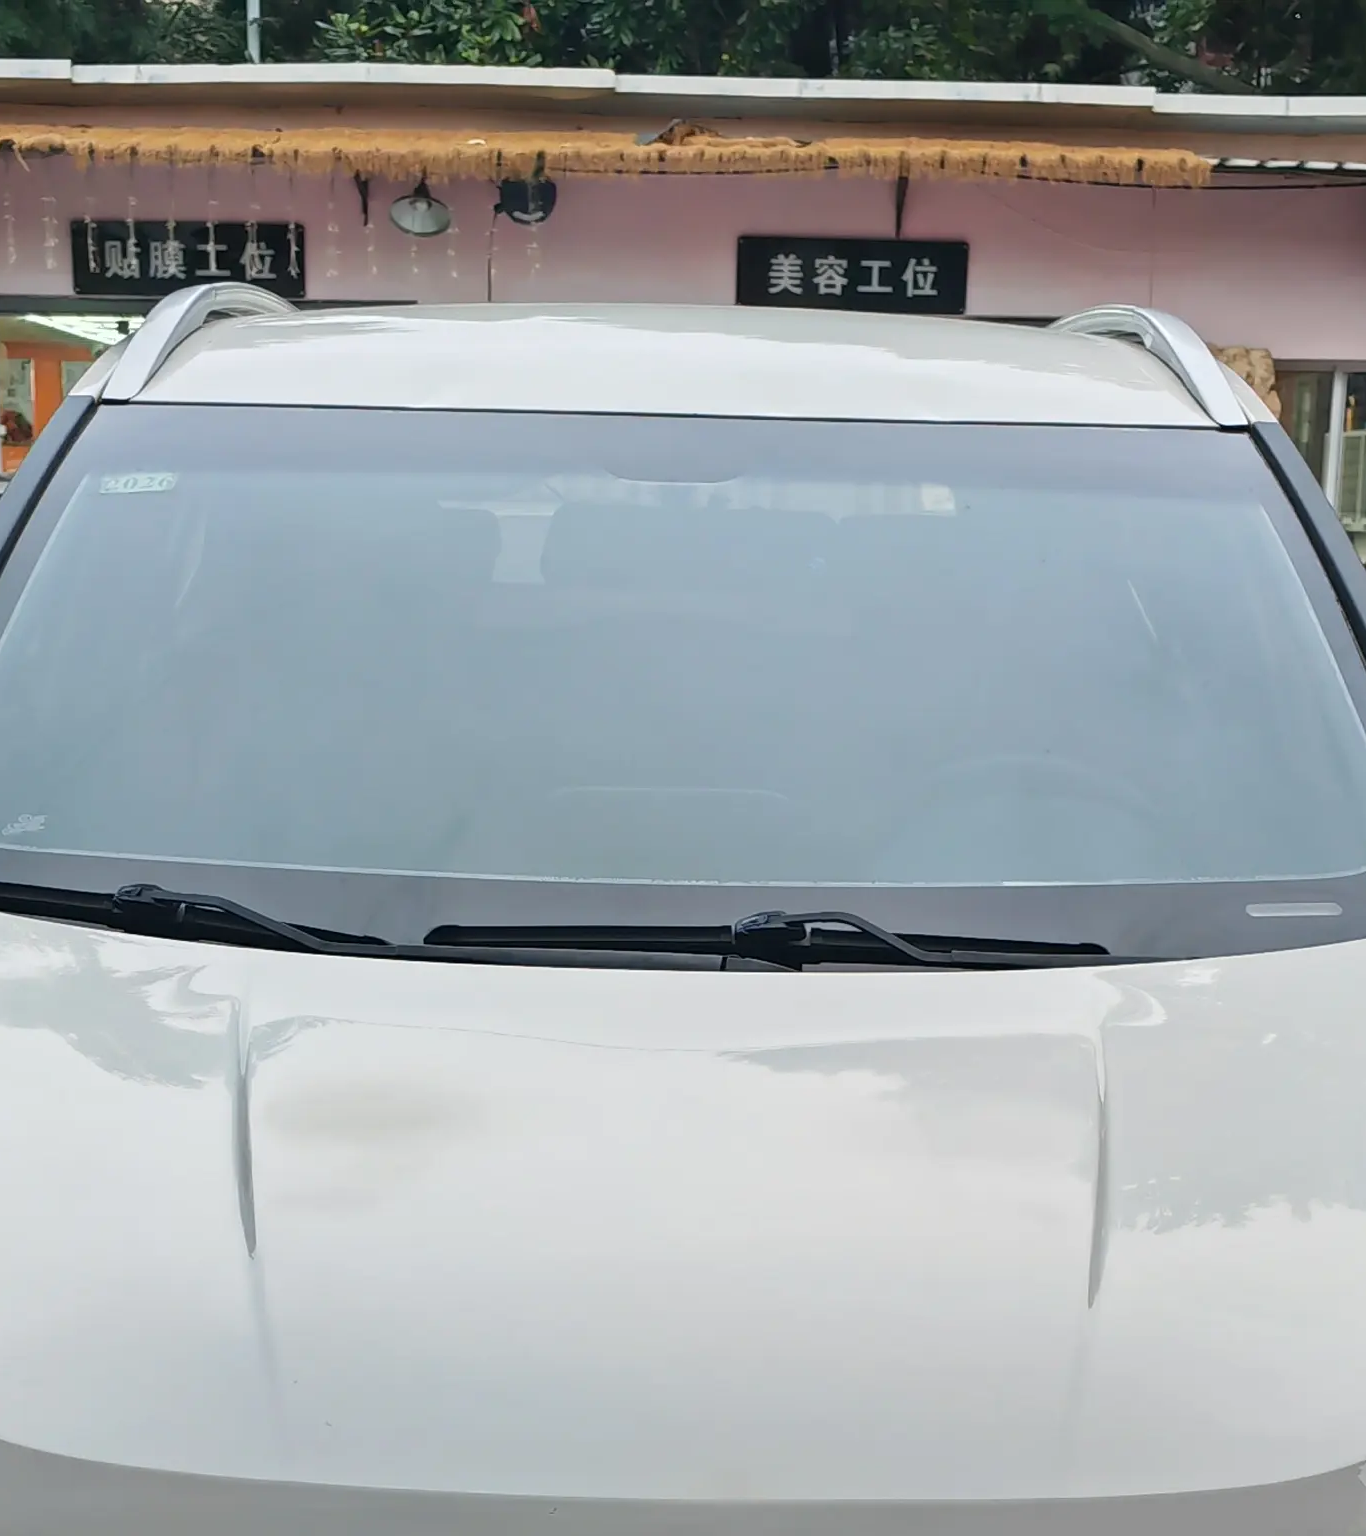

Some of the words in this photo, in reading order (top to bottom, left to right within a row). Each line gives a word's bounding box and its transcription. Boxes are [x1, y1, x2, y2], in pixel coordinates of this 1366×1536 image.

[104, 239, 277, 281] 贴膜工位
[767, 253, 939, 298] 美容工位
